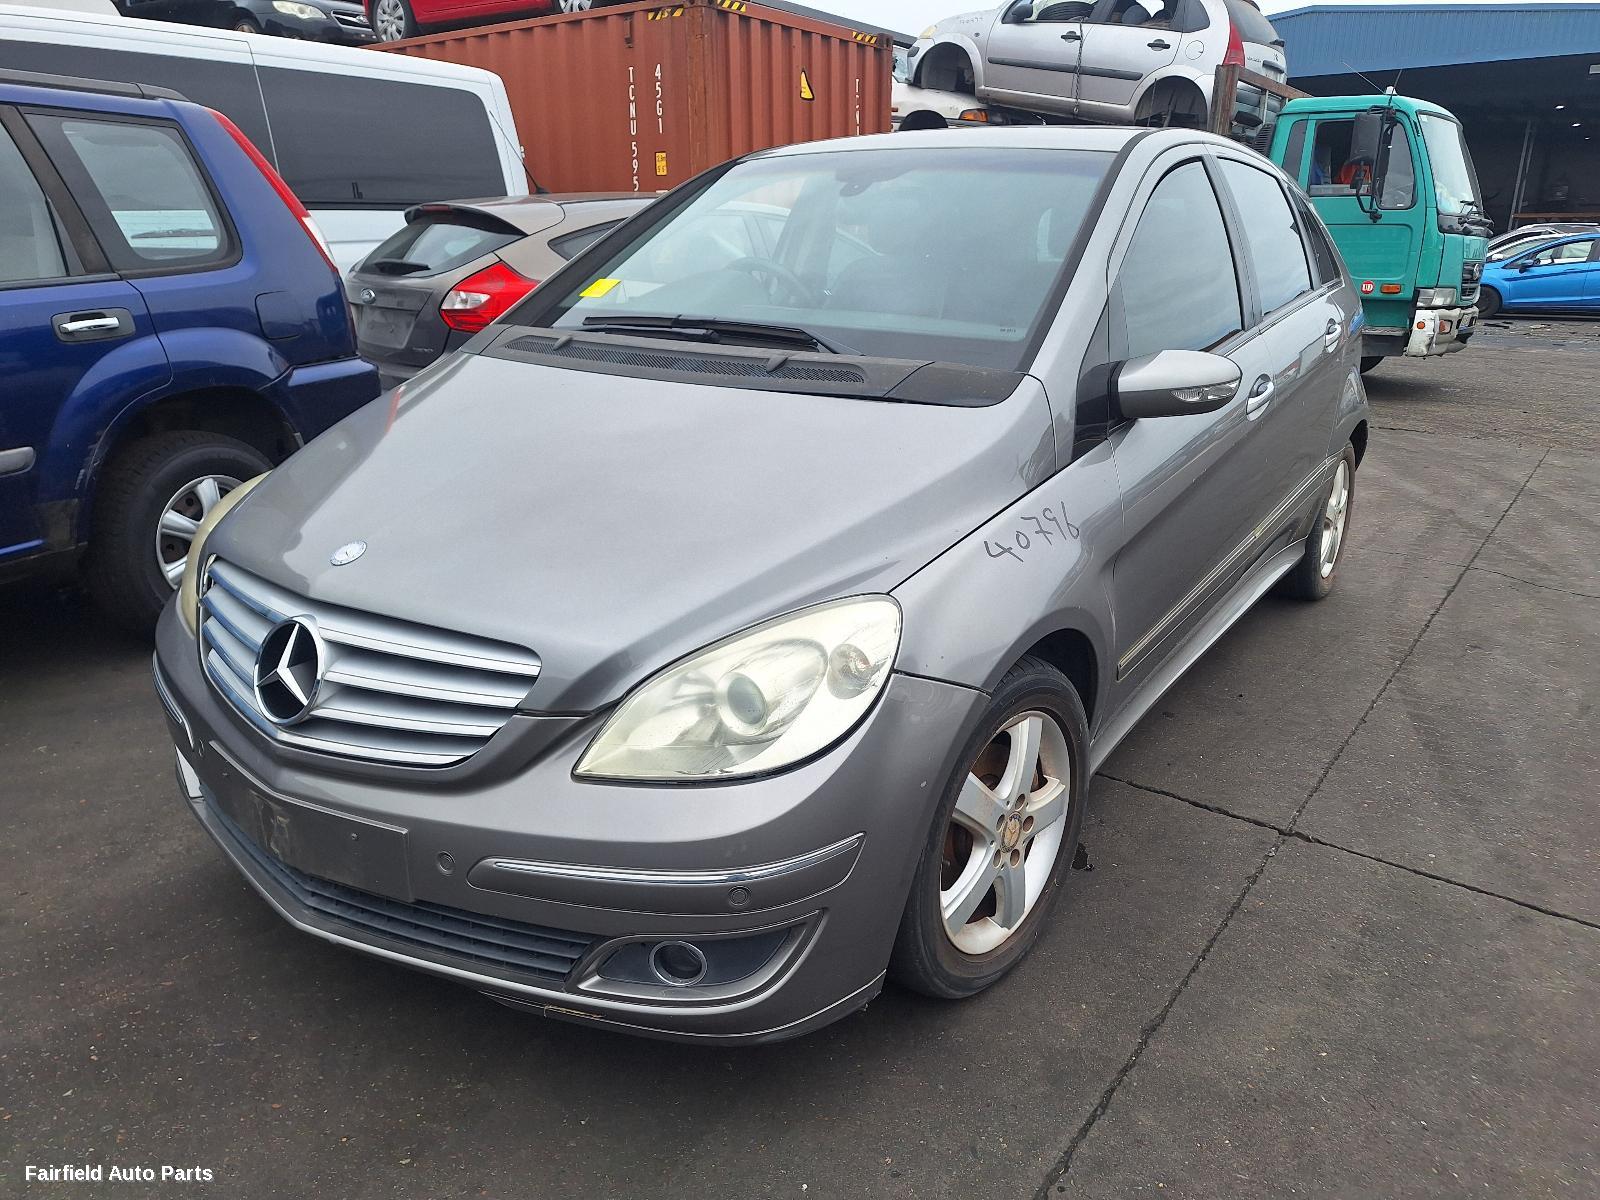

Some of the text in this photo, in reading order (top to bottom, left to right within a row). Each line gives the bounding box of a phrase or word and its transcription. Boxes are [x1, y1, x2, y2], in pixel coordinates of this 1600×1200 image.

[628, 66, 639, 192] TCNU 595
[983, 501, 1080, 563] 40796
